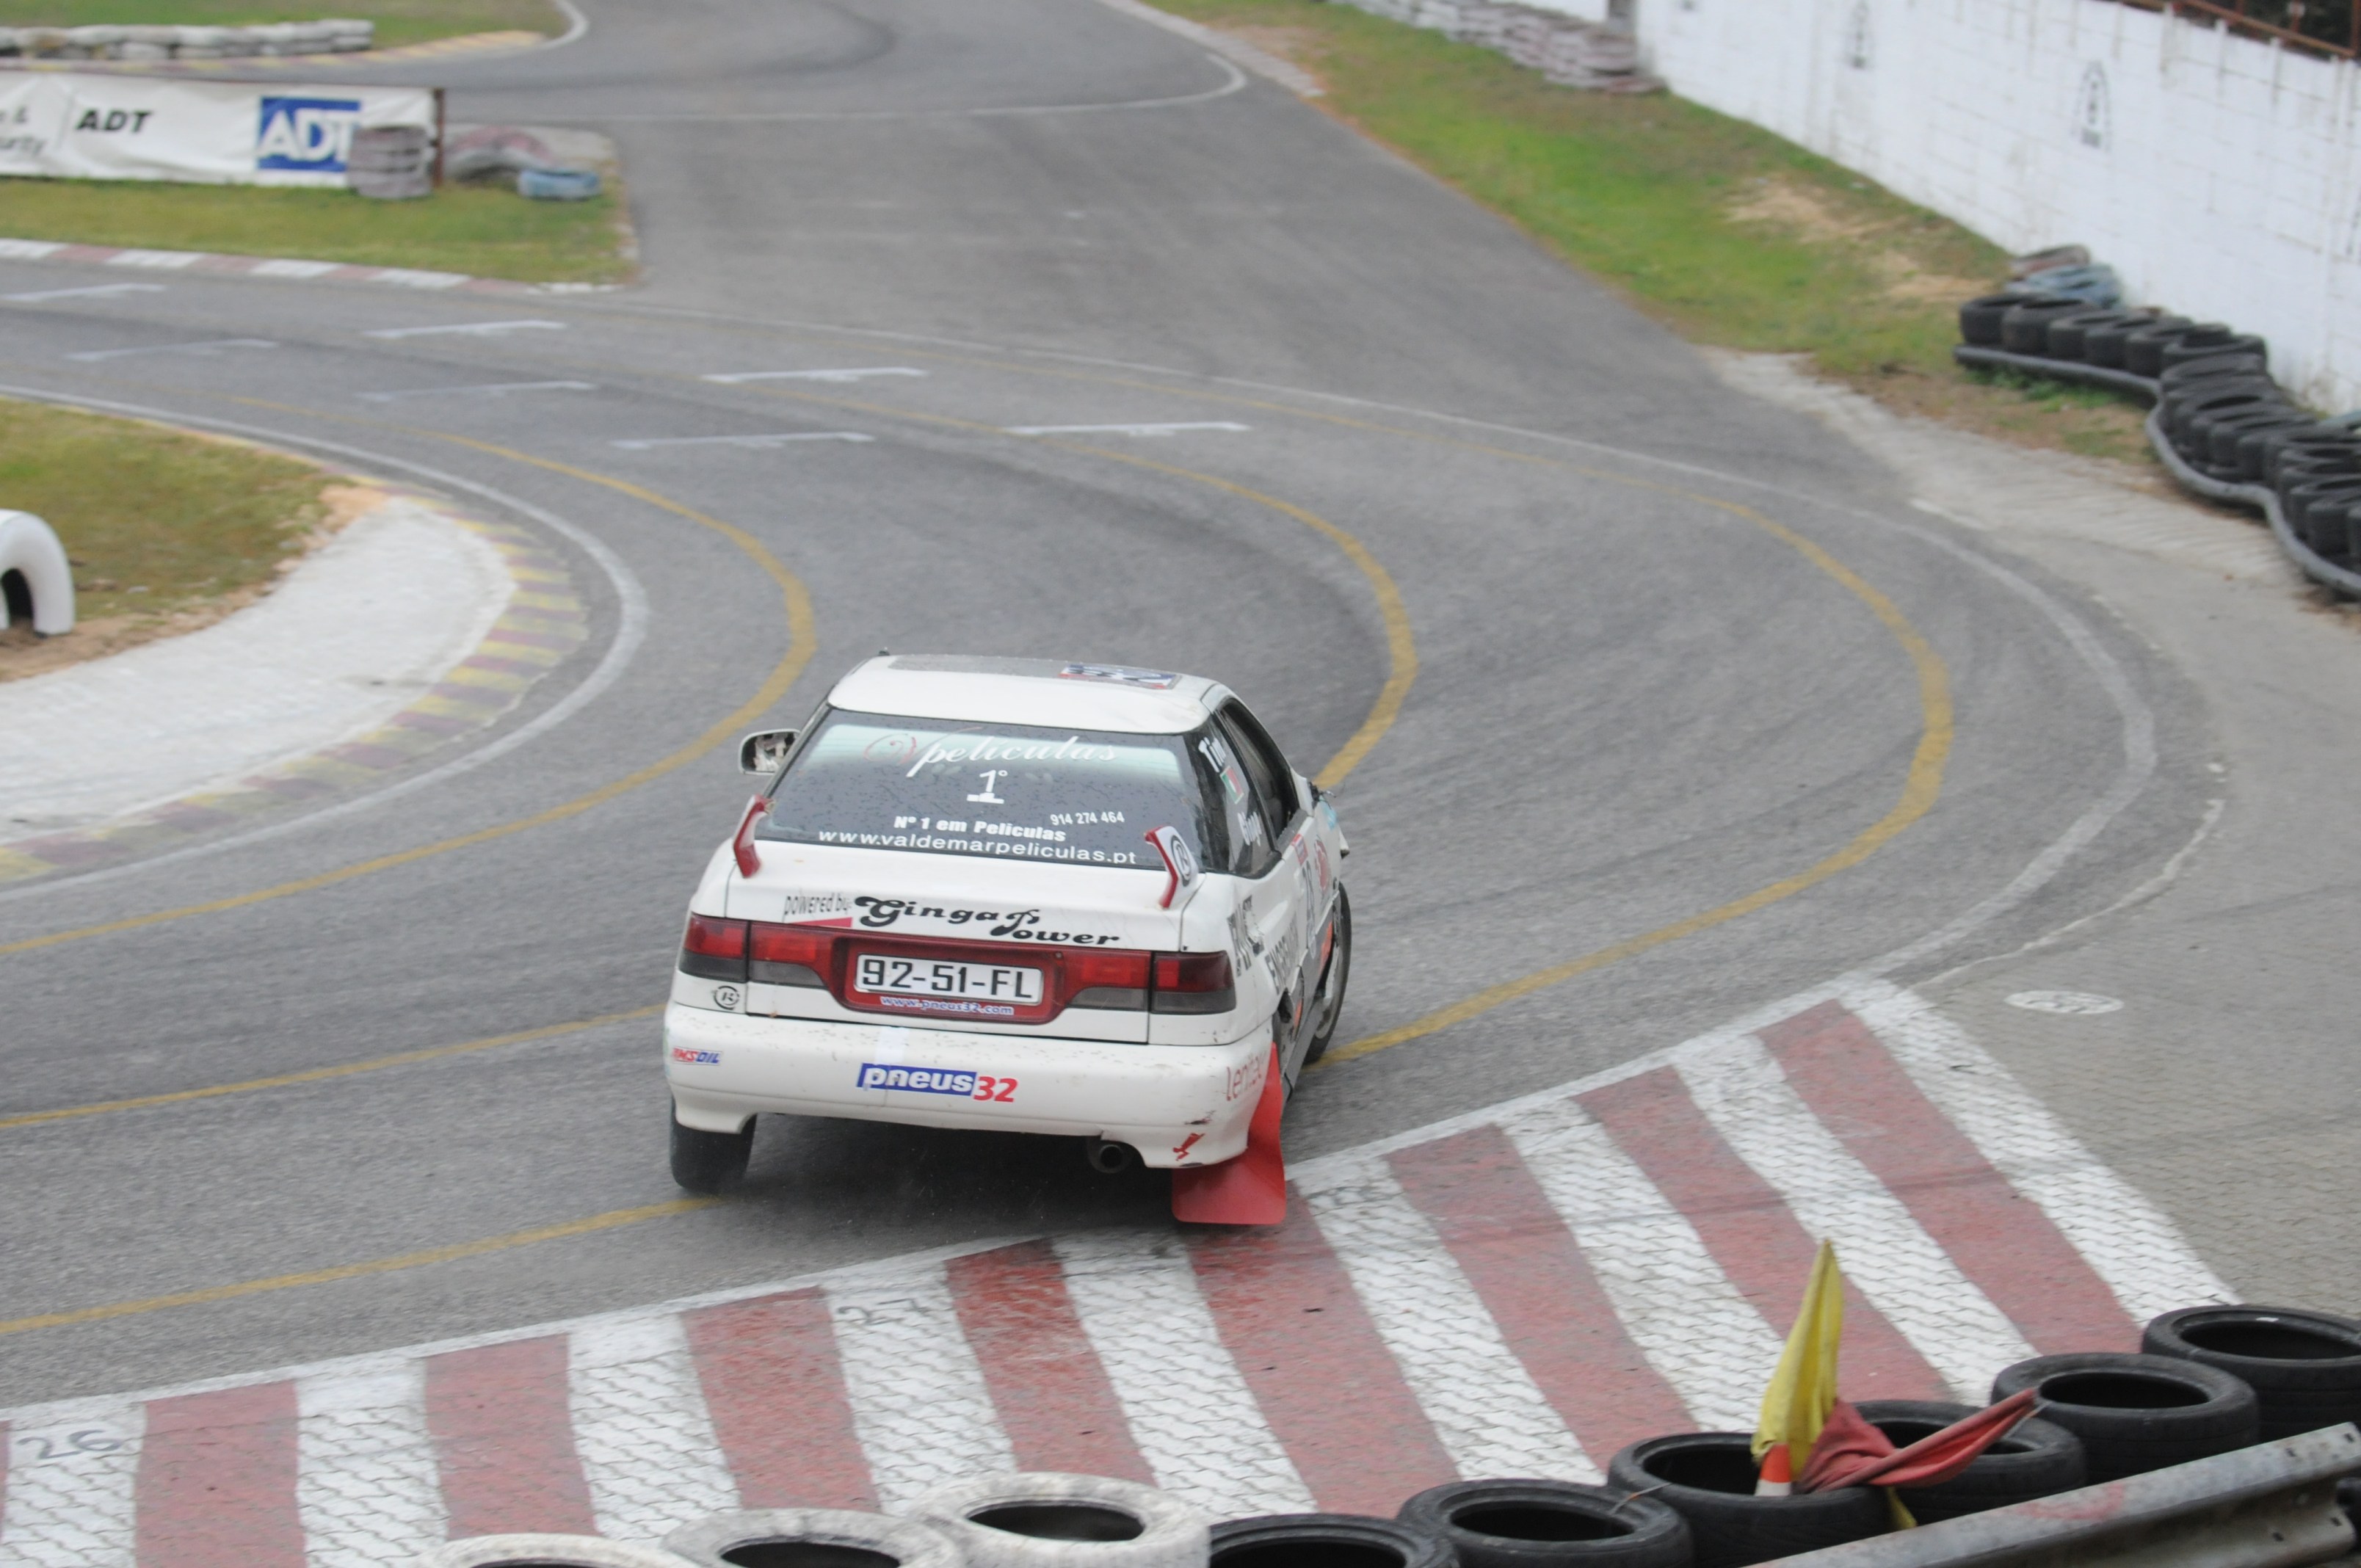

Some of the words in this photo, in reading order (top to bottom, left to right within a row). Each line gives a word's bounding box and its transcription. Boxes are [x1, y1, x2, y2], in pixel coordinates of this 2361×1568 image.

[76, 109, 151, 133] ADT
[257, 107, 361, 162] ADT
[921, 817, 930, 830] 1
[936, 819, 968, 832] em
[973, 821, 1067, 841] Peliculas
[1050, 813, 1073, 826] 914
[1076, 812, 1098, 824] 274
[1101, 811, 1125, 823] 464
[819, 830, 1137, 865] www.valdemarpeliculas.pt
[783, 893, 835, 922] powered
[854, 896, 998, 927] Ginga
[990, 909, 1120, 945] Power
[861, 958, 1033, 1001] 92-51-FL
[880, 995, 1015, 1015] www.pneus32.com
[16, 1429, 123, 1459] 26
